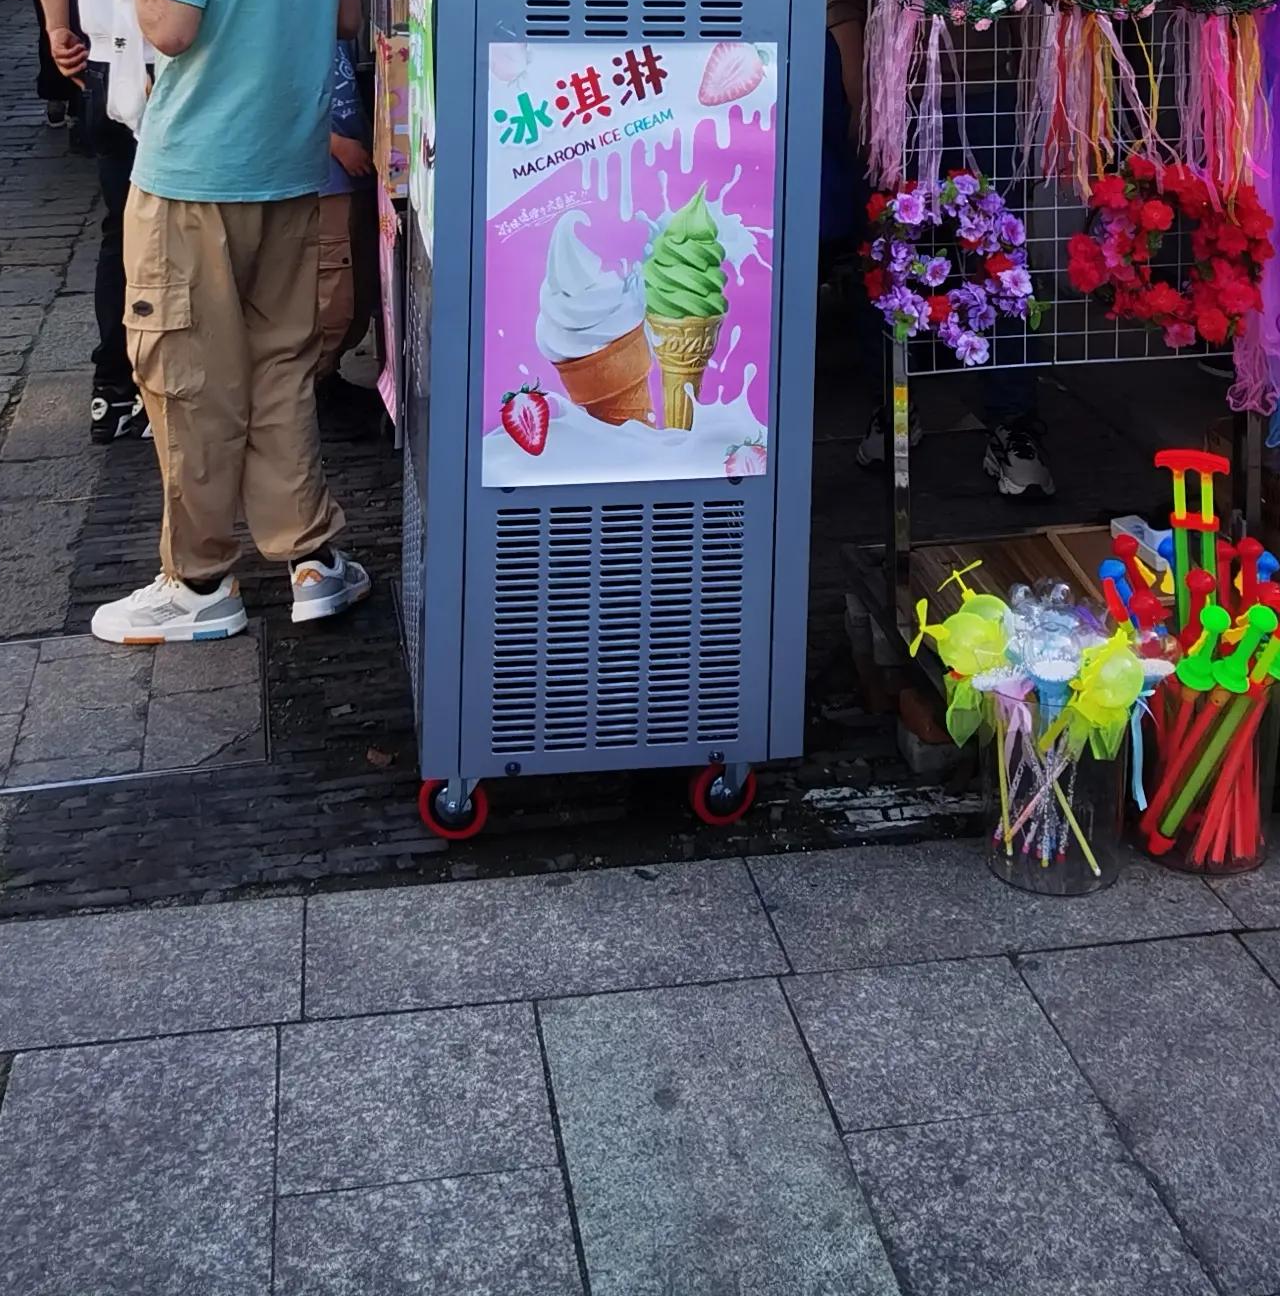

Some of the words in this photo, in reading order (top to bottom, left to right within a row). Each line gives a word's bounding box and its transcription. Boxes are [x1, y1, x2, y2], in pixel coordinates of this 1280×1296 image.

[493, 44, 669, 145] 冰淇淋
[512, 138, 596, 179] MACAROON
[598, 128, 621, 148] ICE
[623, 108, 674, 138] CREAM
